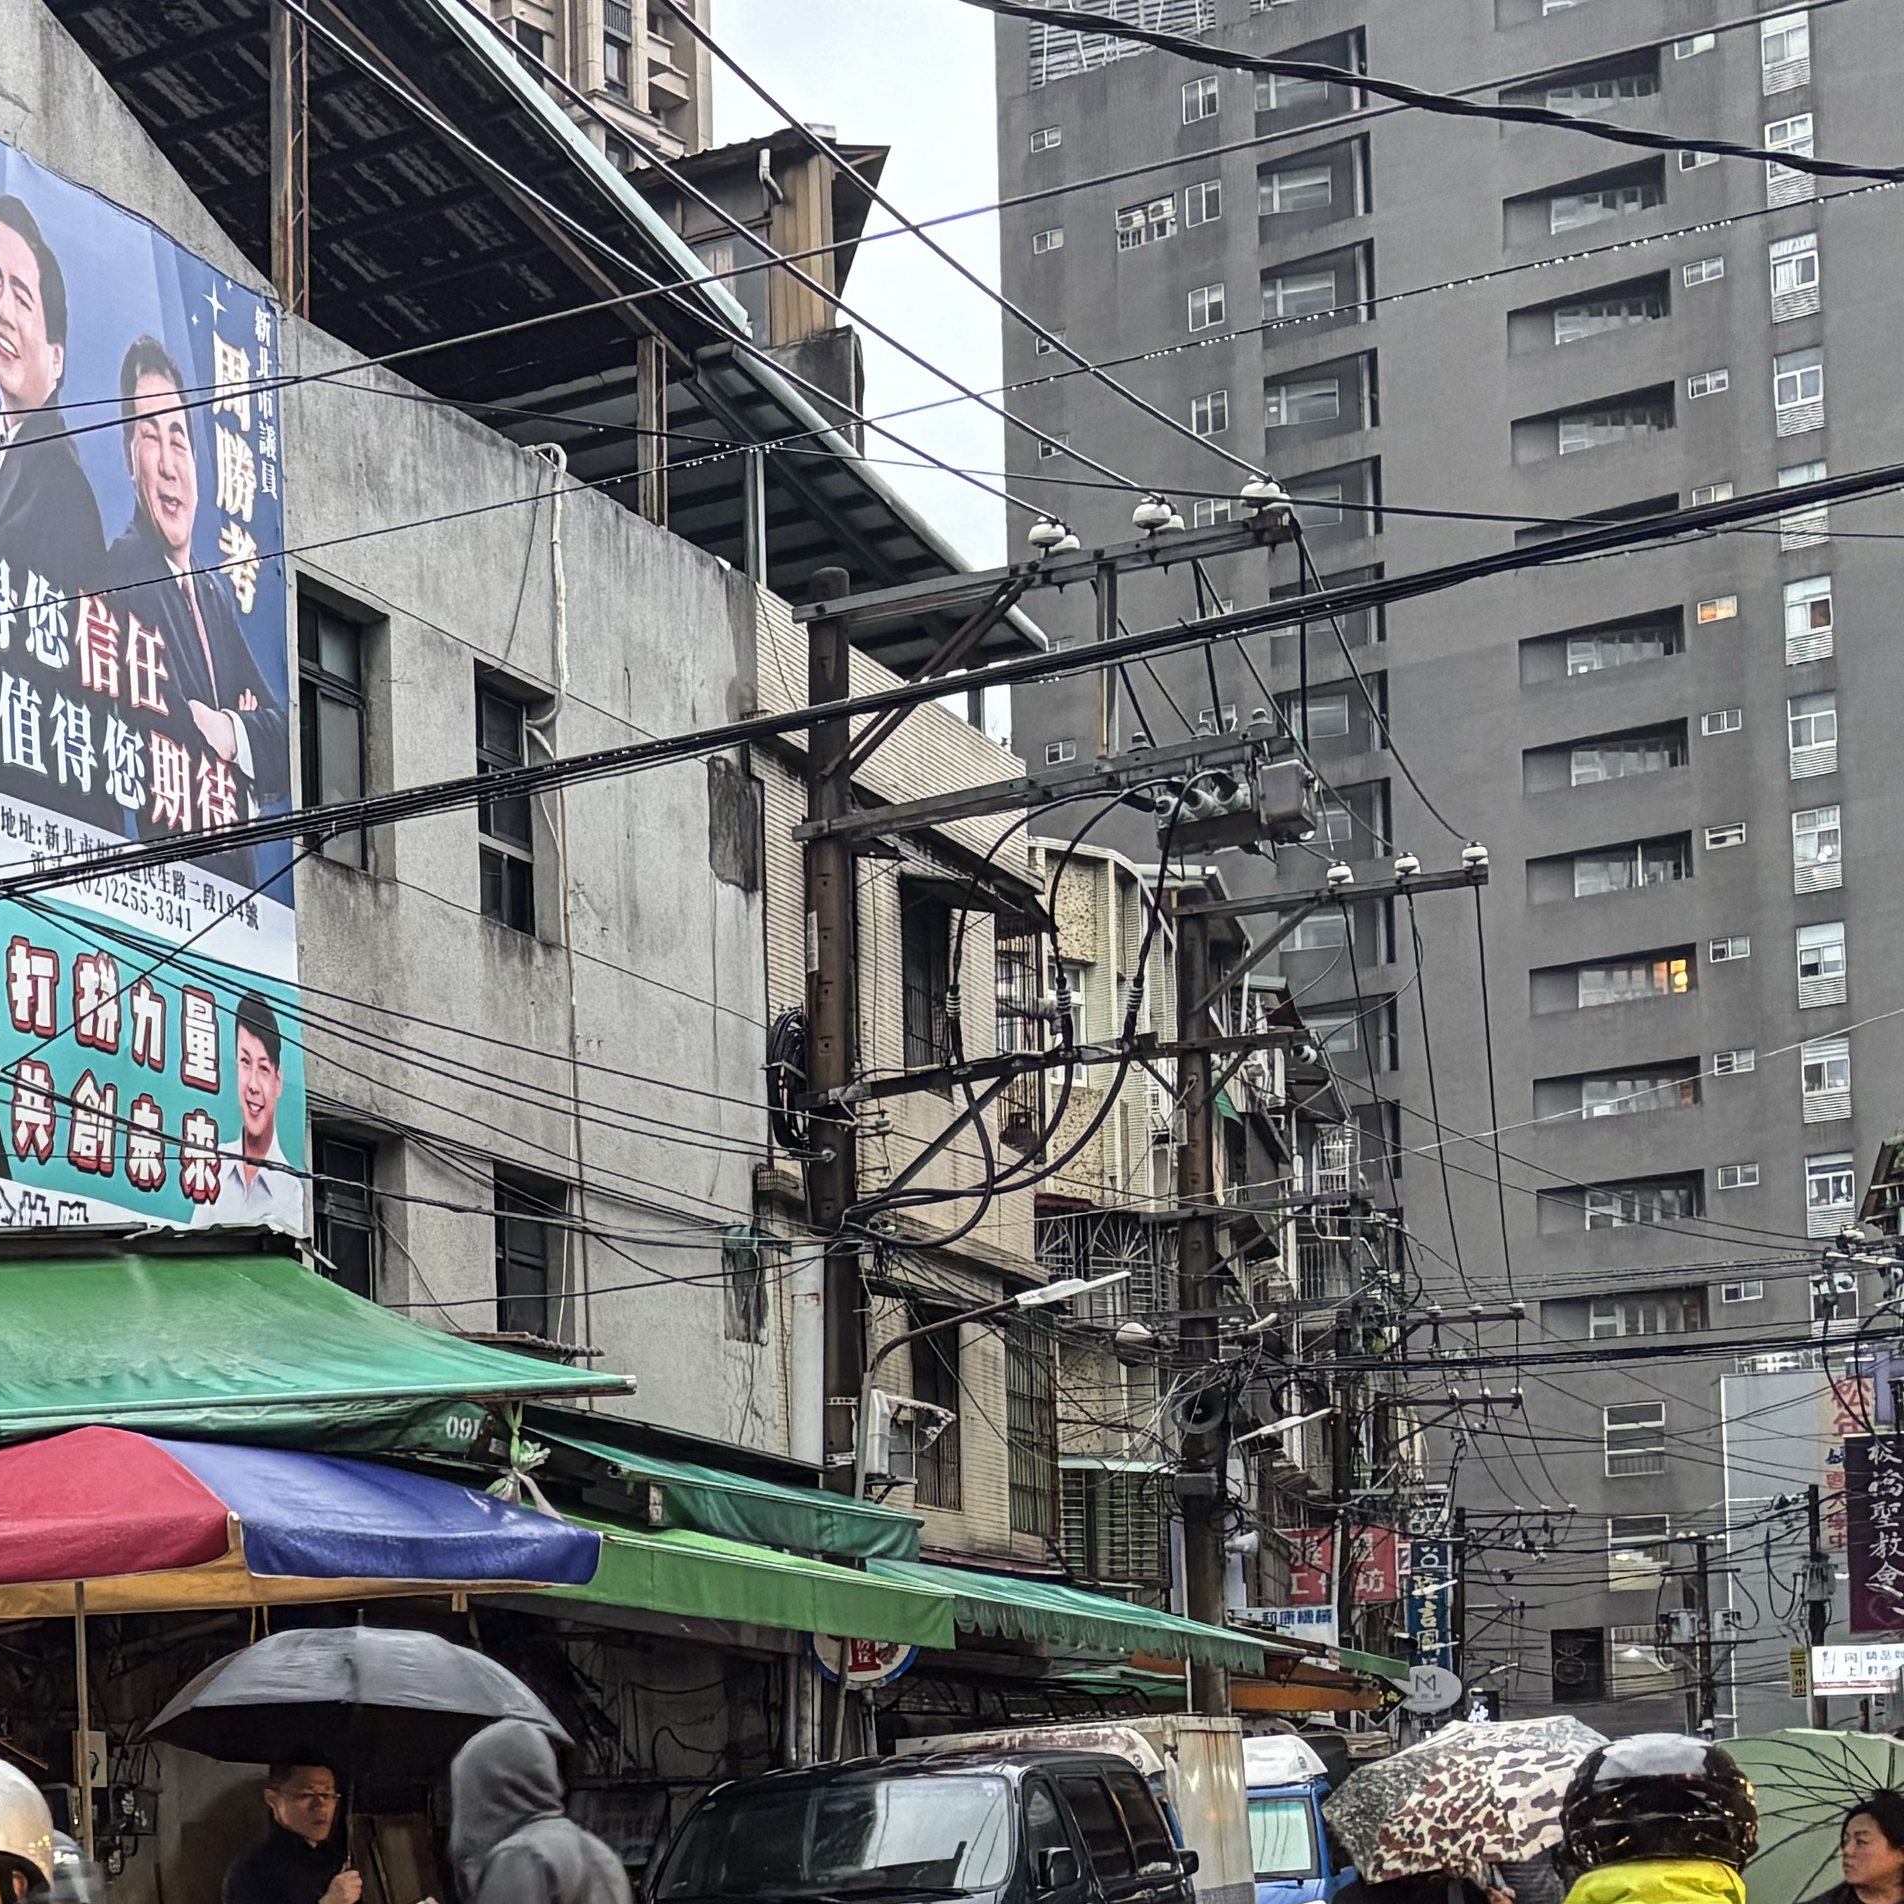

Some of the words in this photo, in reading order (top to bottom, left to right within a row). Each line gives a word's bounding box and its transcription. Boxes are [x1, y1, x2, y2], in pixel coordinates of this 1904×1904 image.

[255, 305, 278, 501] 新北市議員
[10, 1058, 221, 1204] 共創未來
